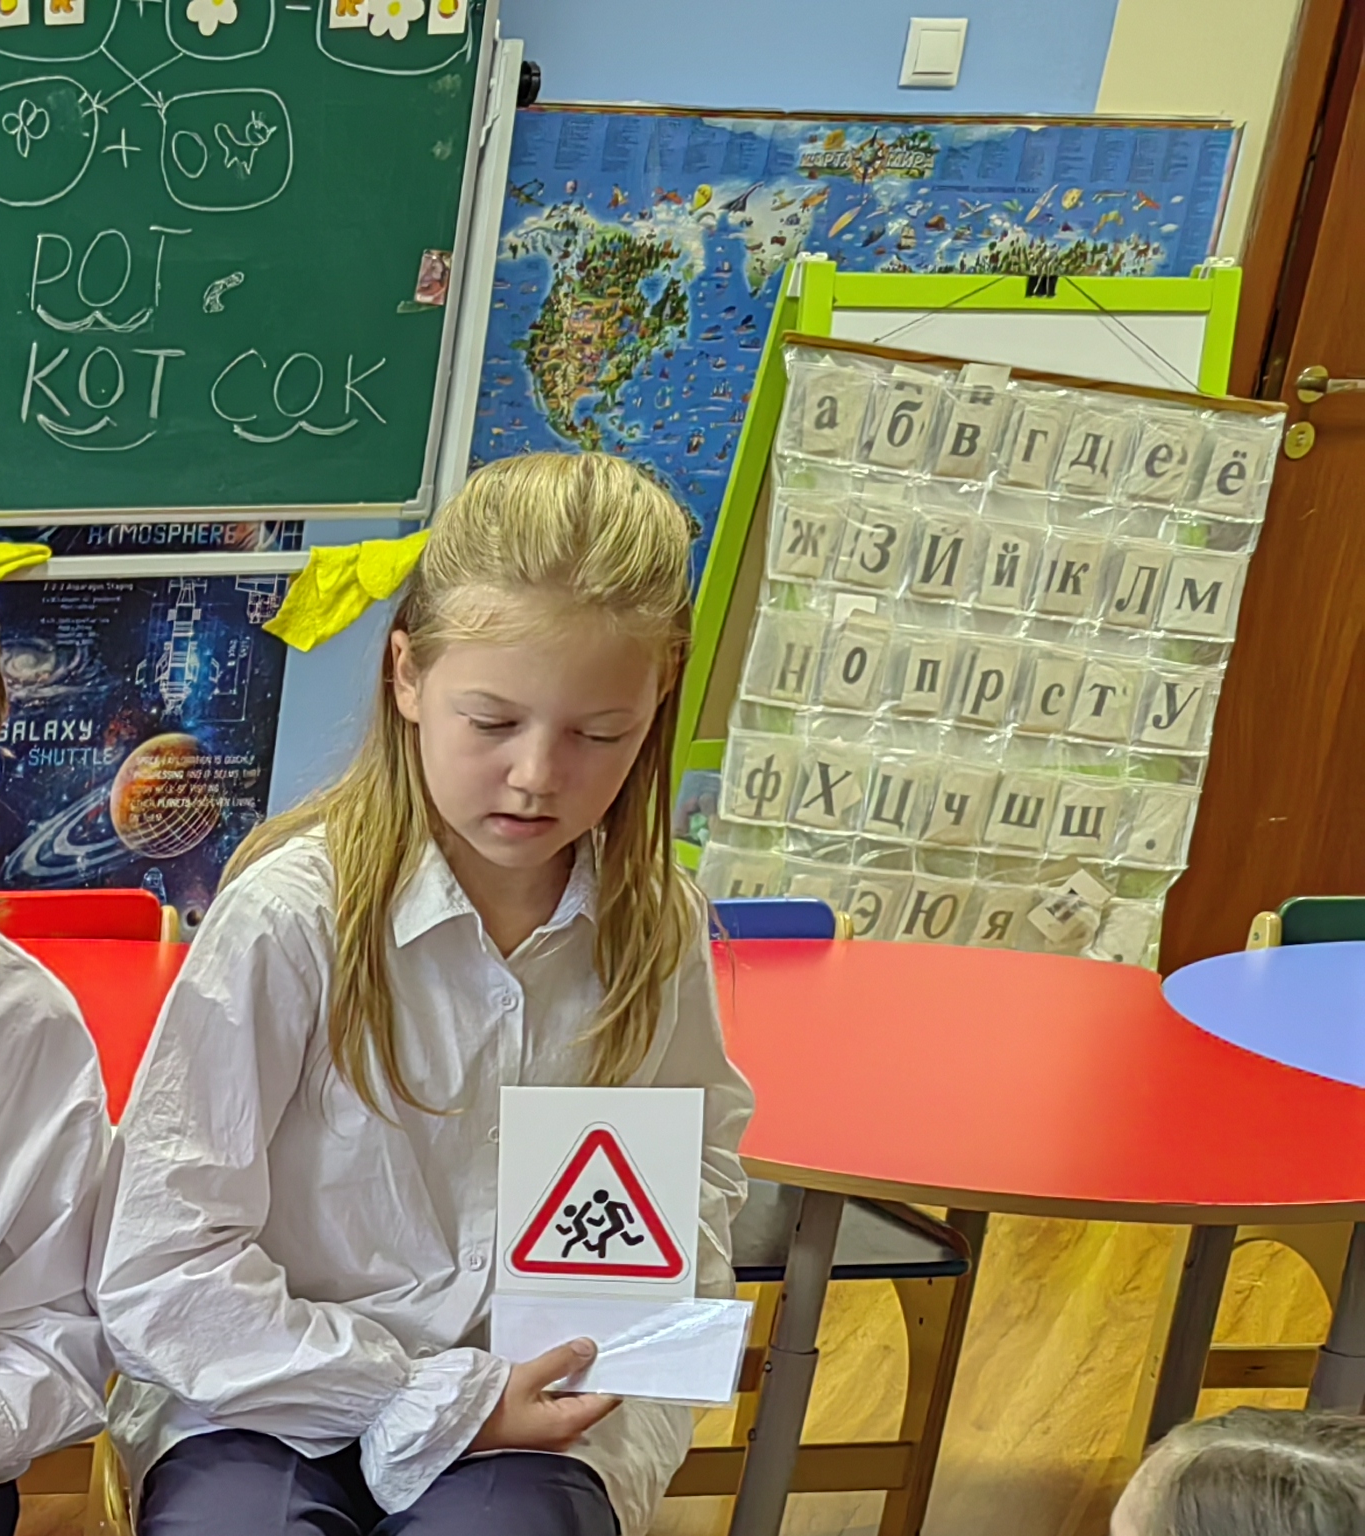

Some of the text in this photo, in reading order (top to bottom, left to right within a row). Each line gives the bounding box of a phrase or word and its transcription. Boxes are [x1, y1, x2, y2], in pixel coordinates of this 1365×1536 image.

[29, 226, 192, 312] РОТ
[21, 342, 387, 425] КОТ СОК
[813, 394, 839, 431] а
[887, 399, 923, 448] б
[950, 422, 981, 457] в
[1021, 428, 1049, 462] г
[1144, 442, 1174, 477] е
[1216, 450, 1247, 496] ё
[87, 523, 238, 546] ATMOSPHERE
[991, 543, 1021, 588] й
[969, 668, 1004, 715] р
[28, 746, 113, 767] SHUTTLE
